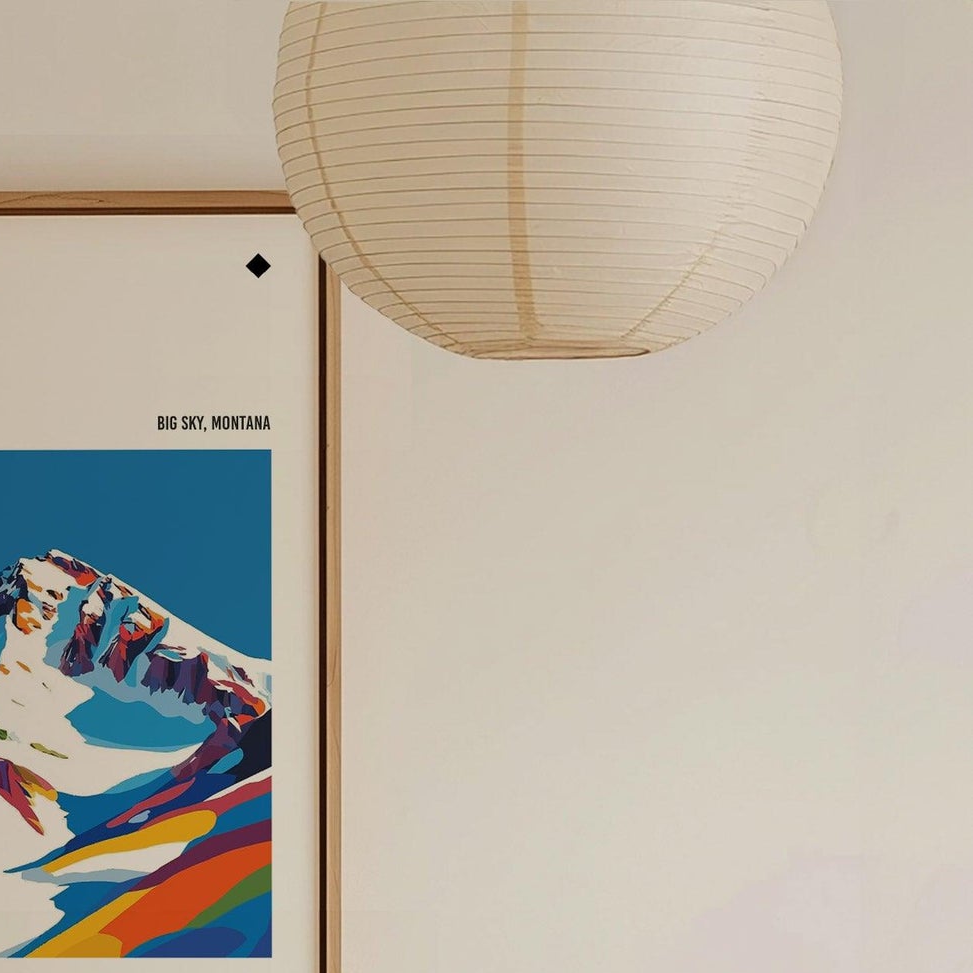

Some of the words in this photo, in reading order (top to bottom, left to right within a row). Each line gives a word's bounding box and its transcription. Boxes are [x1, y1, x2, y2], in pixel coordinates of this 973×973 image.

[157, 415, 178, 431] BIG
[181, 415, 207, 433] SKY,
[211, 415, 271, 431] MONTANA
